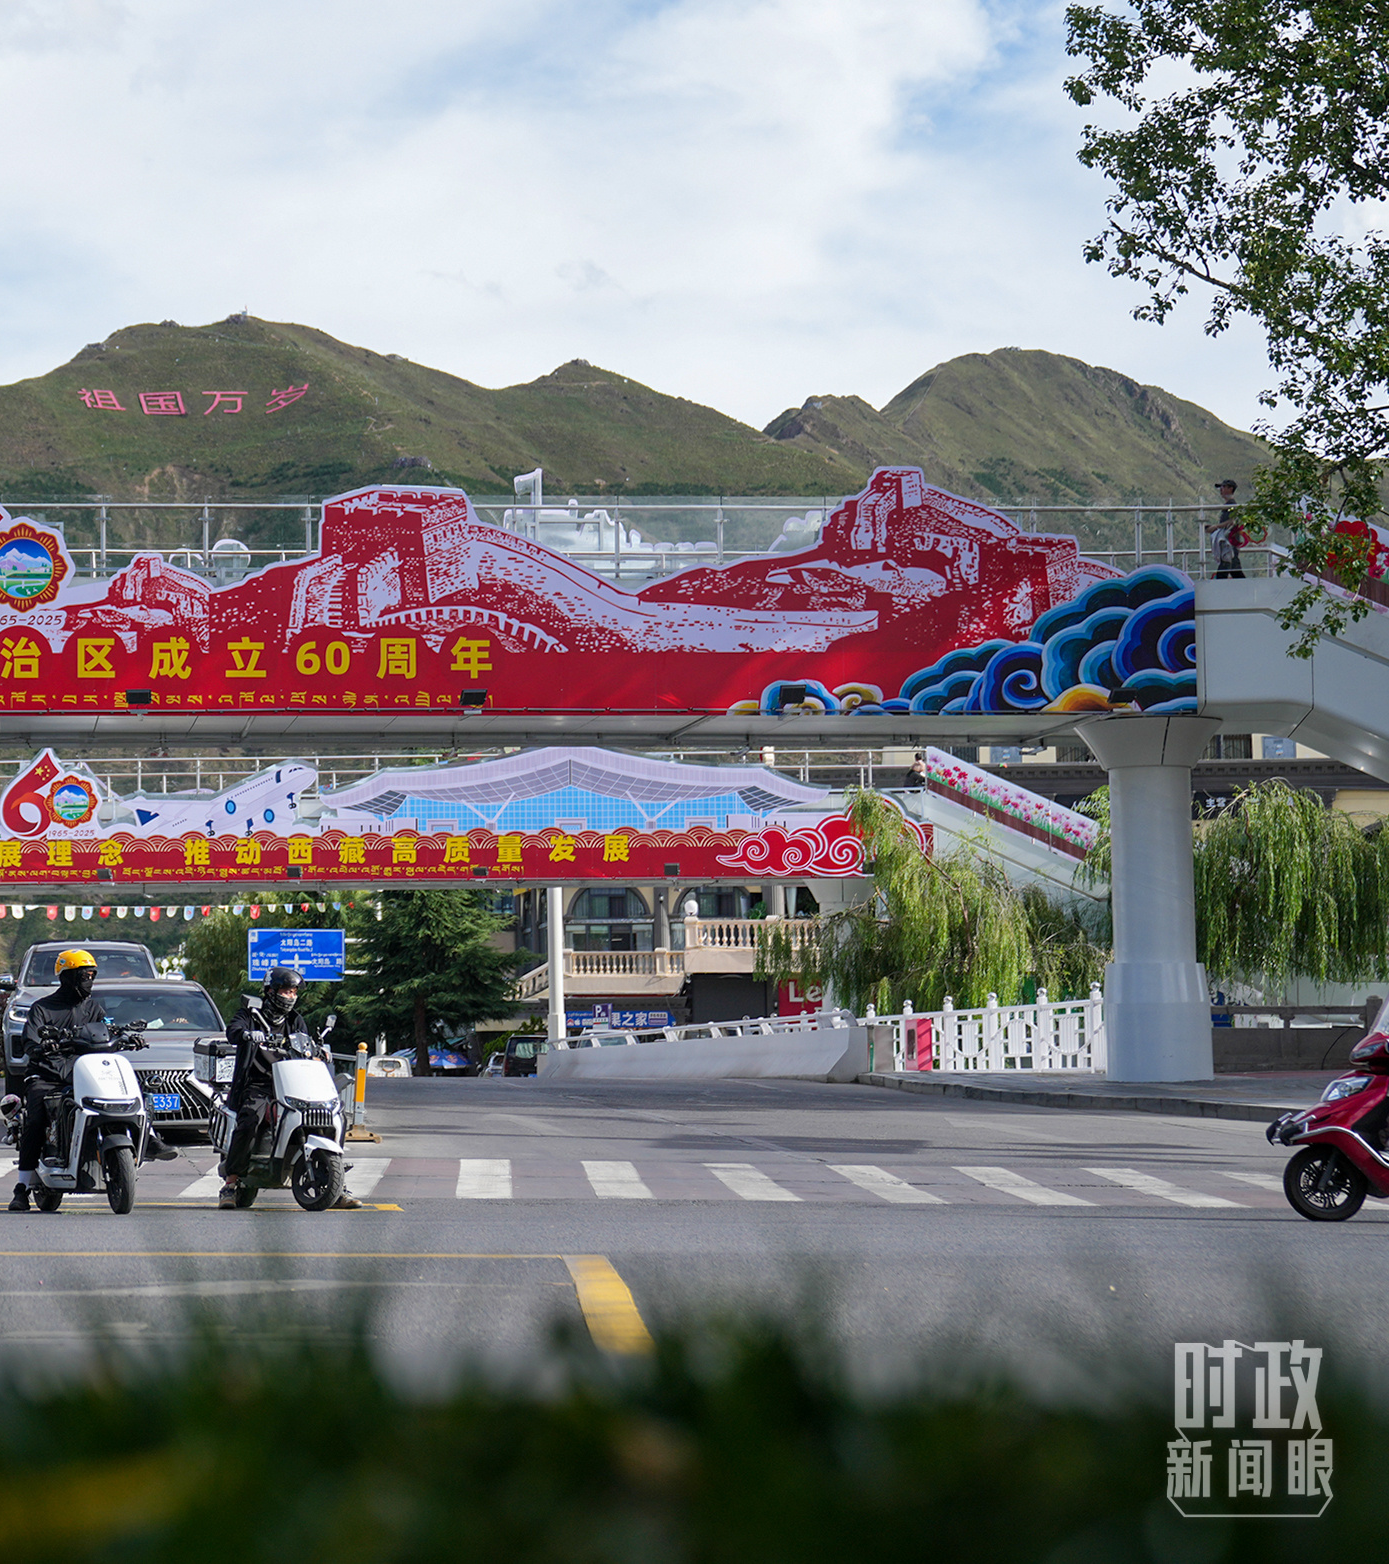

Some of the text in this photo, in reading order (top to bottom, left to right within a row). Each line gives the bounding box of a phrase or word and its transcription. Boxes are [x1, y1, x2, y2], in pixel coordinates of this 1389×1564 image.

[77, 383, 309, 415] 祖国万岁
[183, 835, 630, 866] 推动西藏高质量发展
